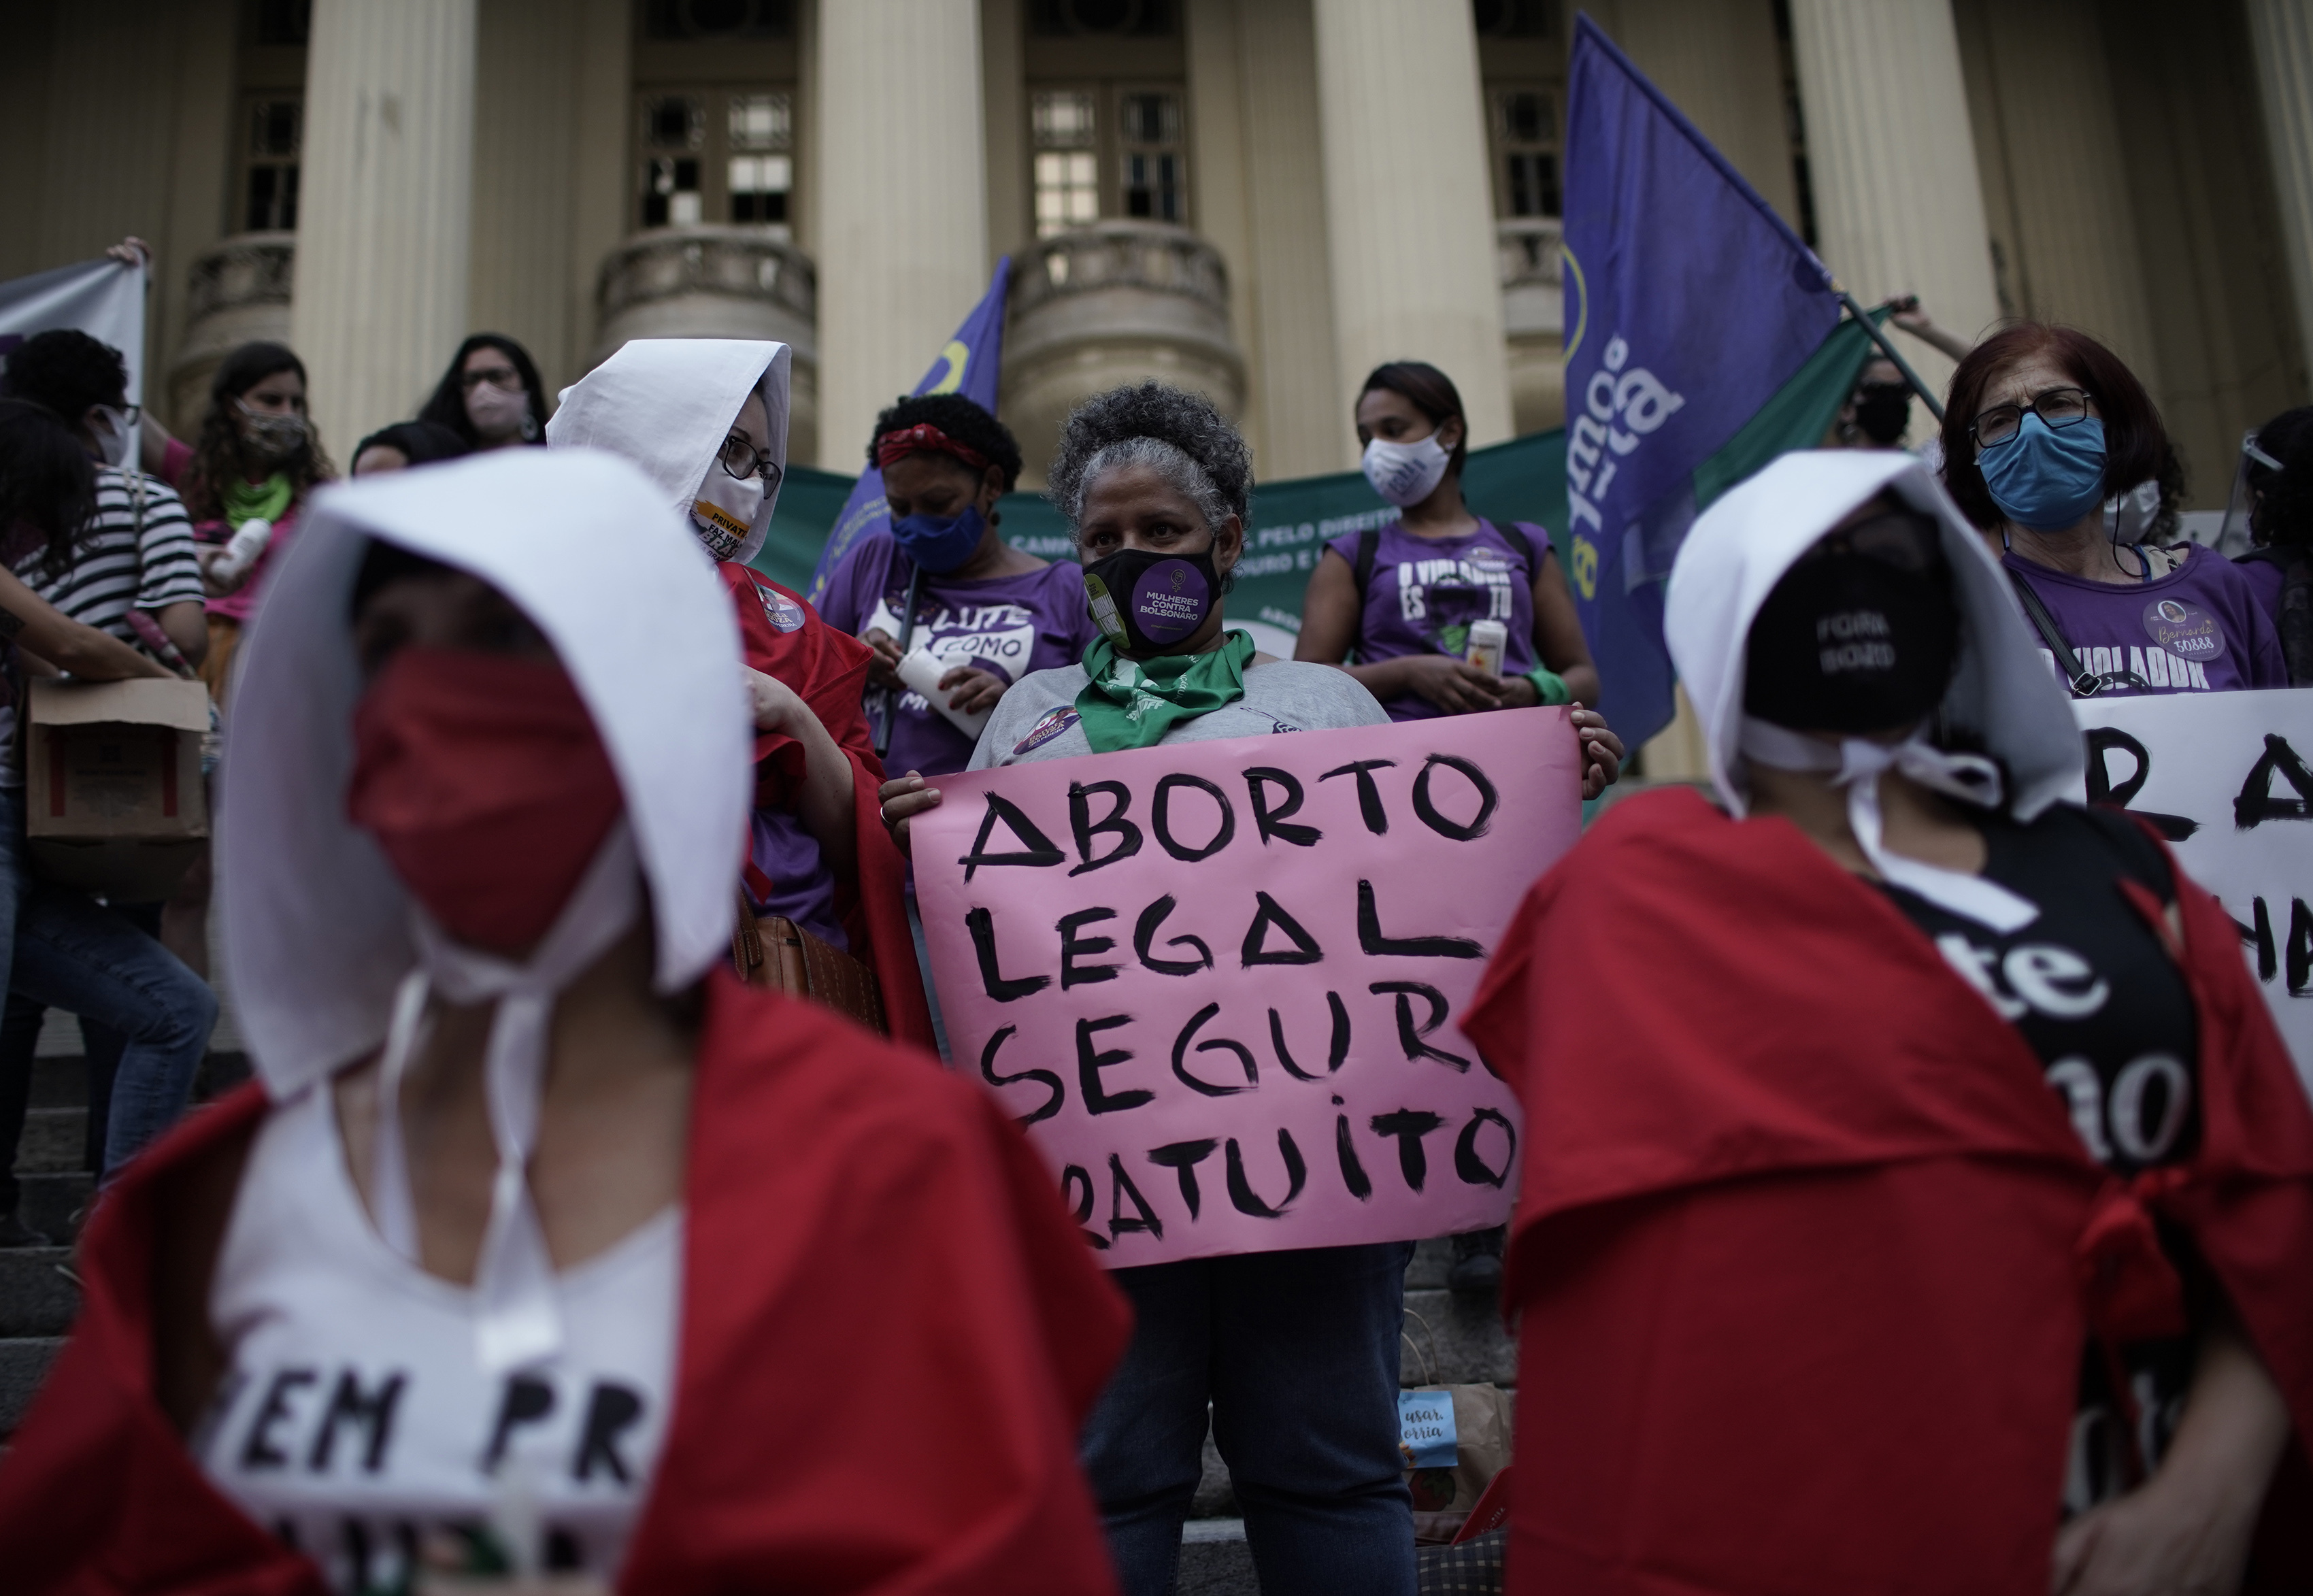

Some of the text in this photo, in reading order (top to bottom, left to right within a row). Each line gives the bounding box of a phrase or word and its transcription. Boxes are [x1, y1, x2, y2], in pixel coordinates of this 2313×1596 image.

[708, 524, 725, 538] FAZ
[1146, 591, 1199, 606] MULHERES
[1152, 600, 1191, 613] CONTRA
[931, 605, 1033, 632] LUTE
[1139, 605, 1198, 621] BOLSONARO
[2159, 620, 2214, 644] Bernarda
[944, 636, 1021, 657] COMO
[958, 753, 1499, 884] ABORTO
[965, 878, 1487, 1002] LEGAL
[980, 980, 1472, 1133] SEGUR
[1405, 1409, 1444, 1423] usar.
